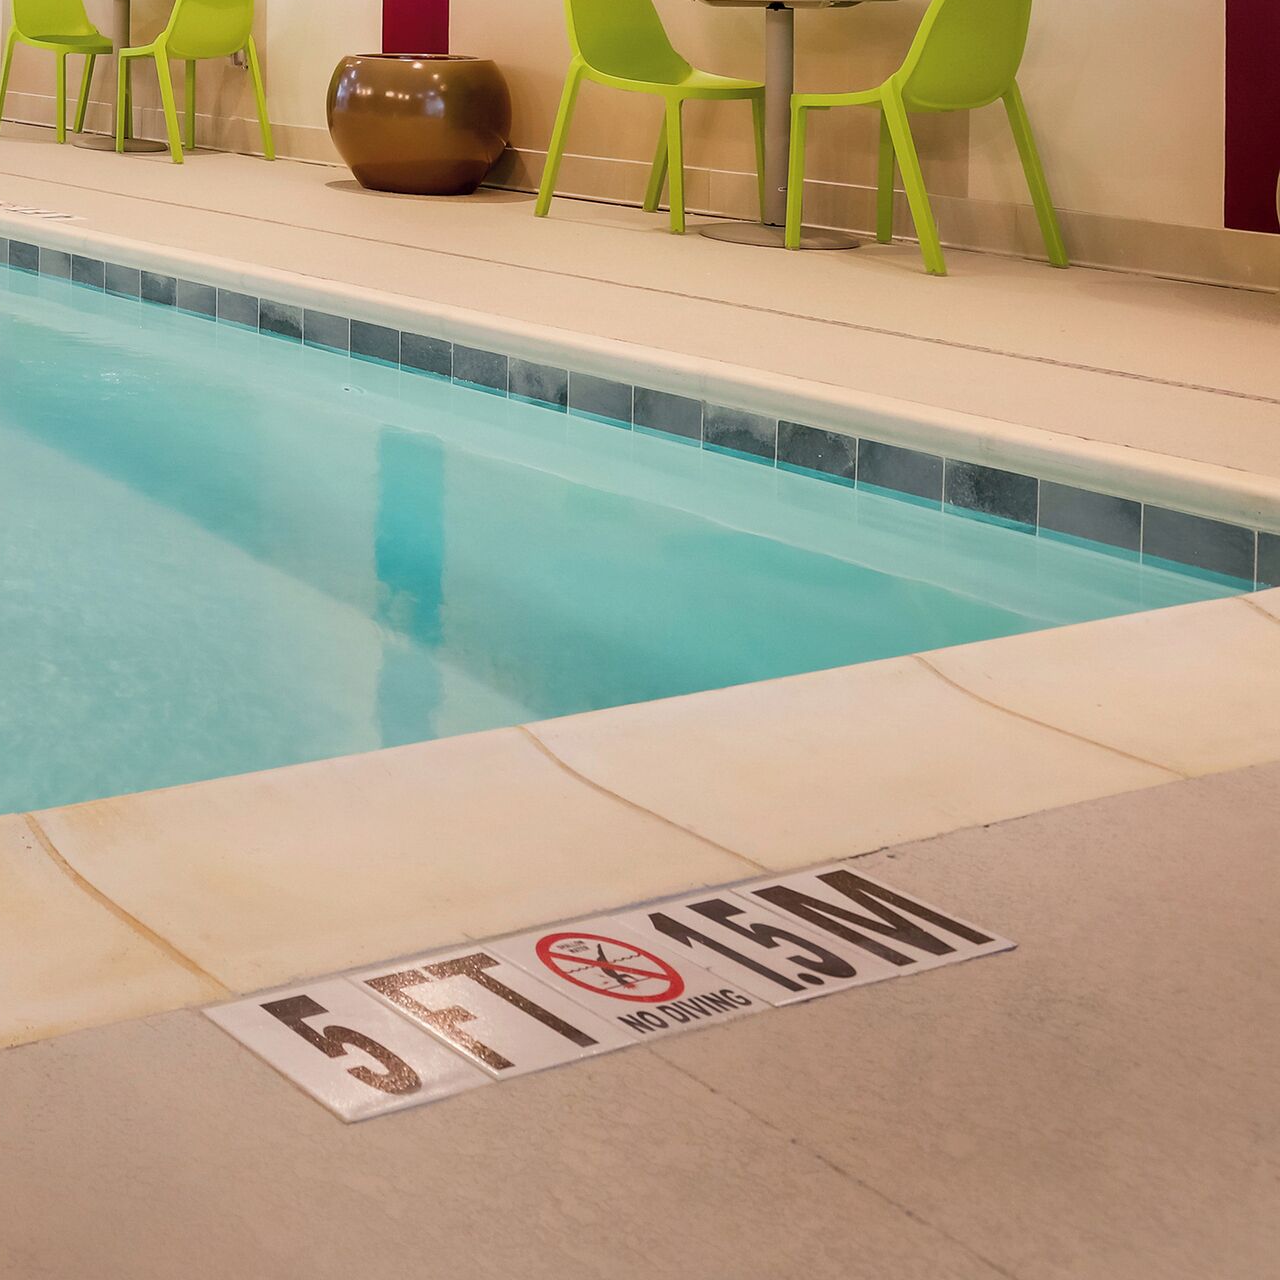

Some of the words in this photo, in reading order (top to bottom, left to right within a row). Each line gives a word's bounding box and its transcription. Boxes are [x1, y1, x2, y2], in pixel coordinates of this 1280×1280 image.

[258, 994, 422, 1095] 5
[363, 951, 600, 1071] FT
[617, 1010, 669, 1034] NO
[655, 988, 753, 1023] DIVING
